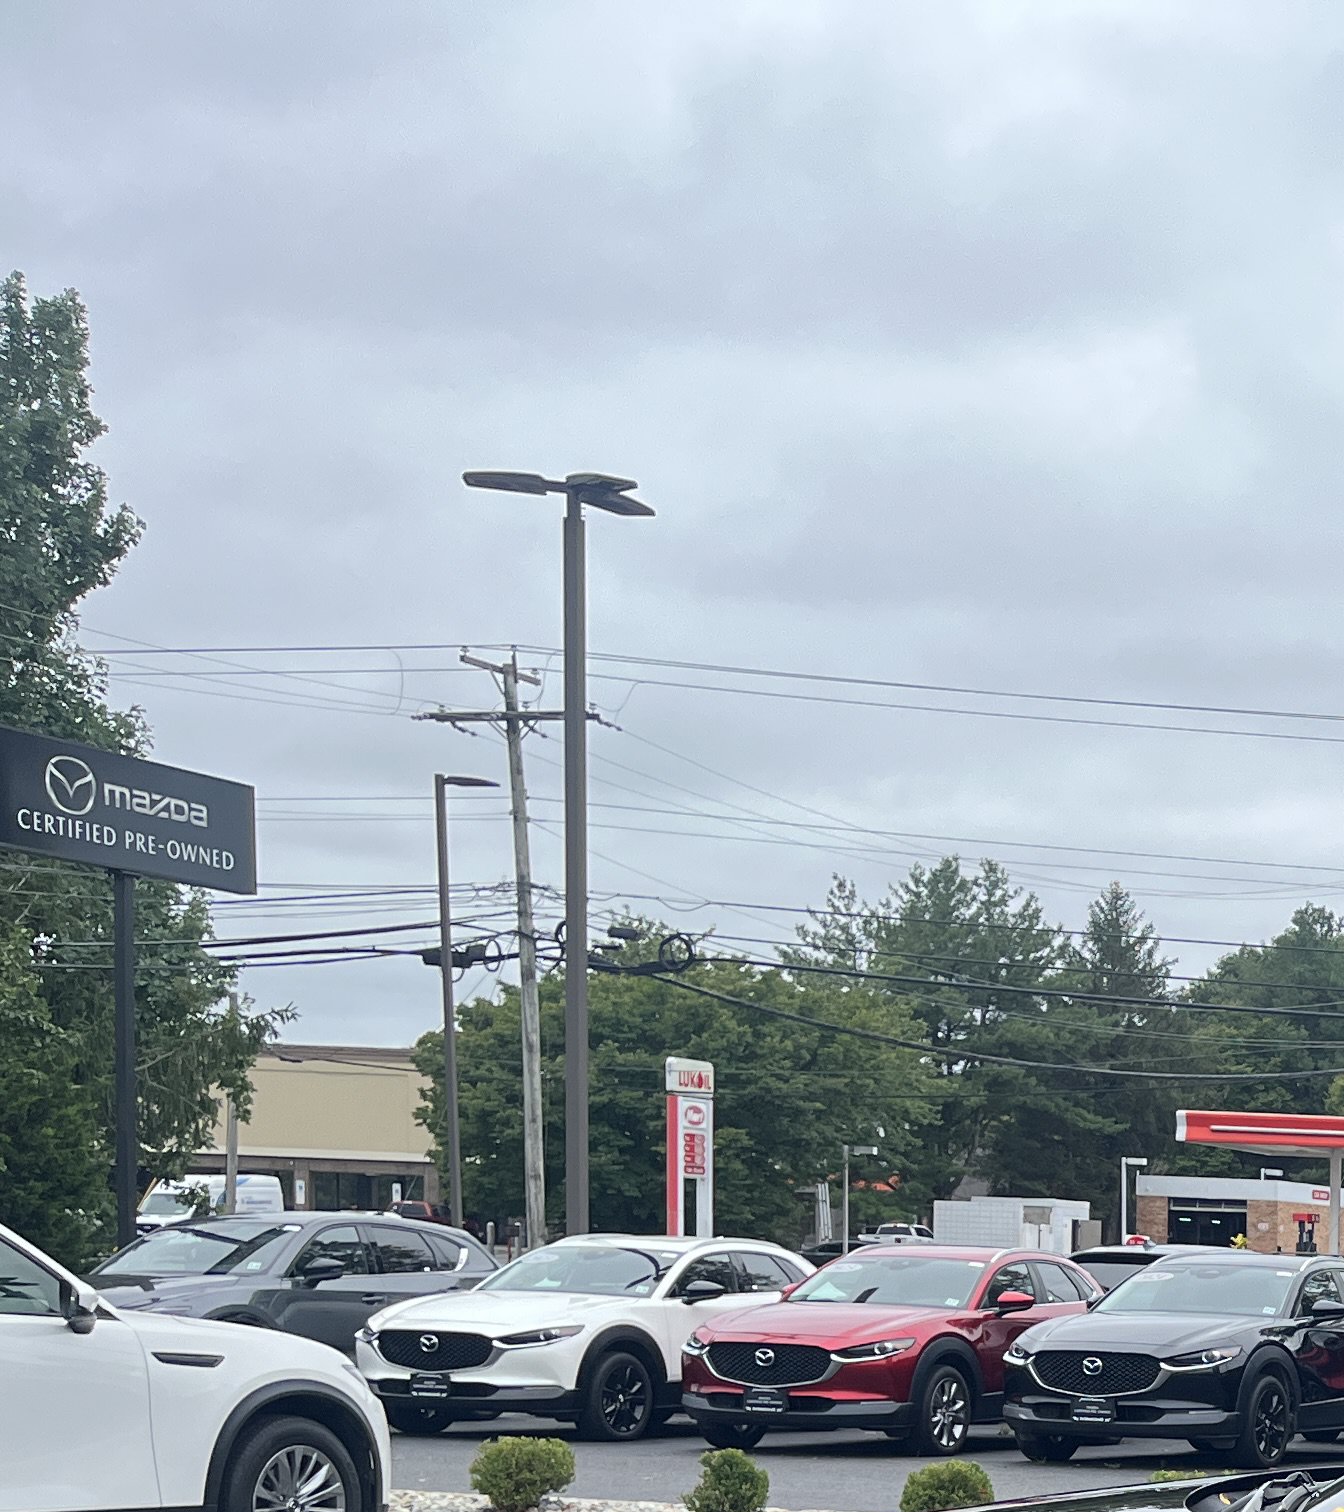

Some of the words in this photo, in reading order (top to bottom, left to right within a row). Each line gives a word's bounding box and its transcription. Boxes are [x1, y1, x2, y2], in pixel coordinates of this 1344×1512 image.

[103, 782, 209, 828] mazda
[17, 808, 117, 846] CERTIFIED
[124, 830, 235, 871] PRE-OWNED
